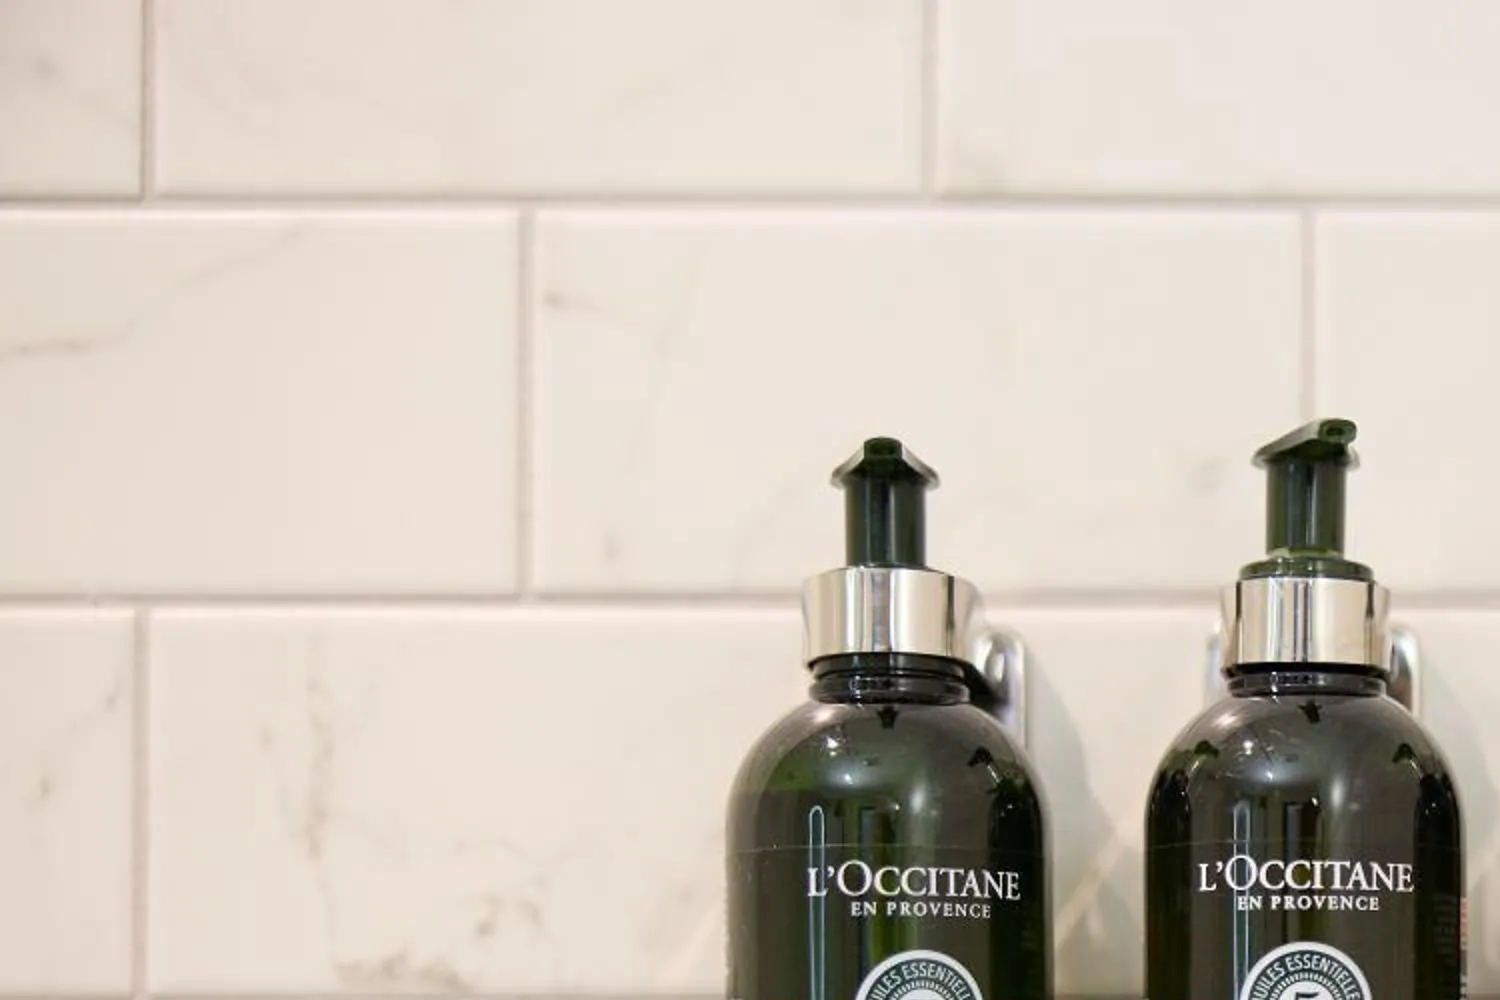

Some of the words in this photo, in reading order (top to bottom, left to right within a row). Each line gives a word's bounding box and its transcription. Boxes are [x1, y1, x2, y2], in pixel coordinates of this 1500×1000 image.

[807, 859, 1021, 901] L'OCCITANE
[1198, 855, 1415, 893] L'OCCITANE
[851, 901, 877, 916] EN
[886, 902, 991, 919] PROVENCE
[1238, 895, 1261, 911] EN
[1271, 895, 1380, 911] PROVENCE
